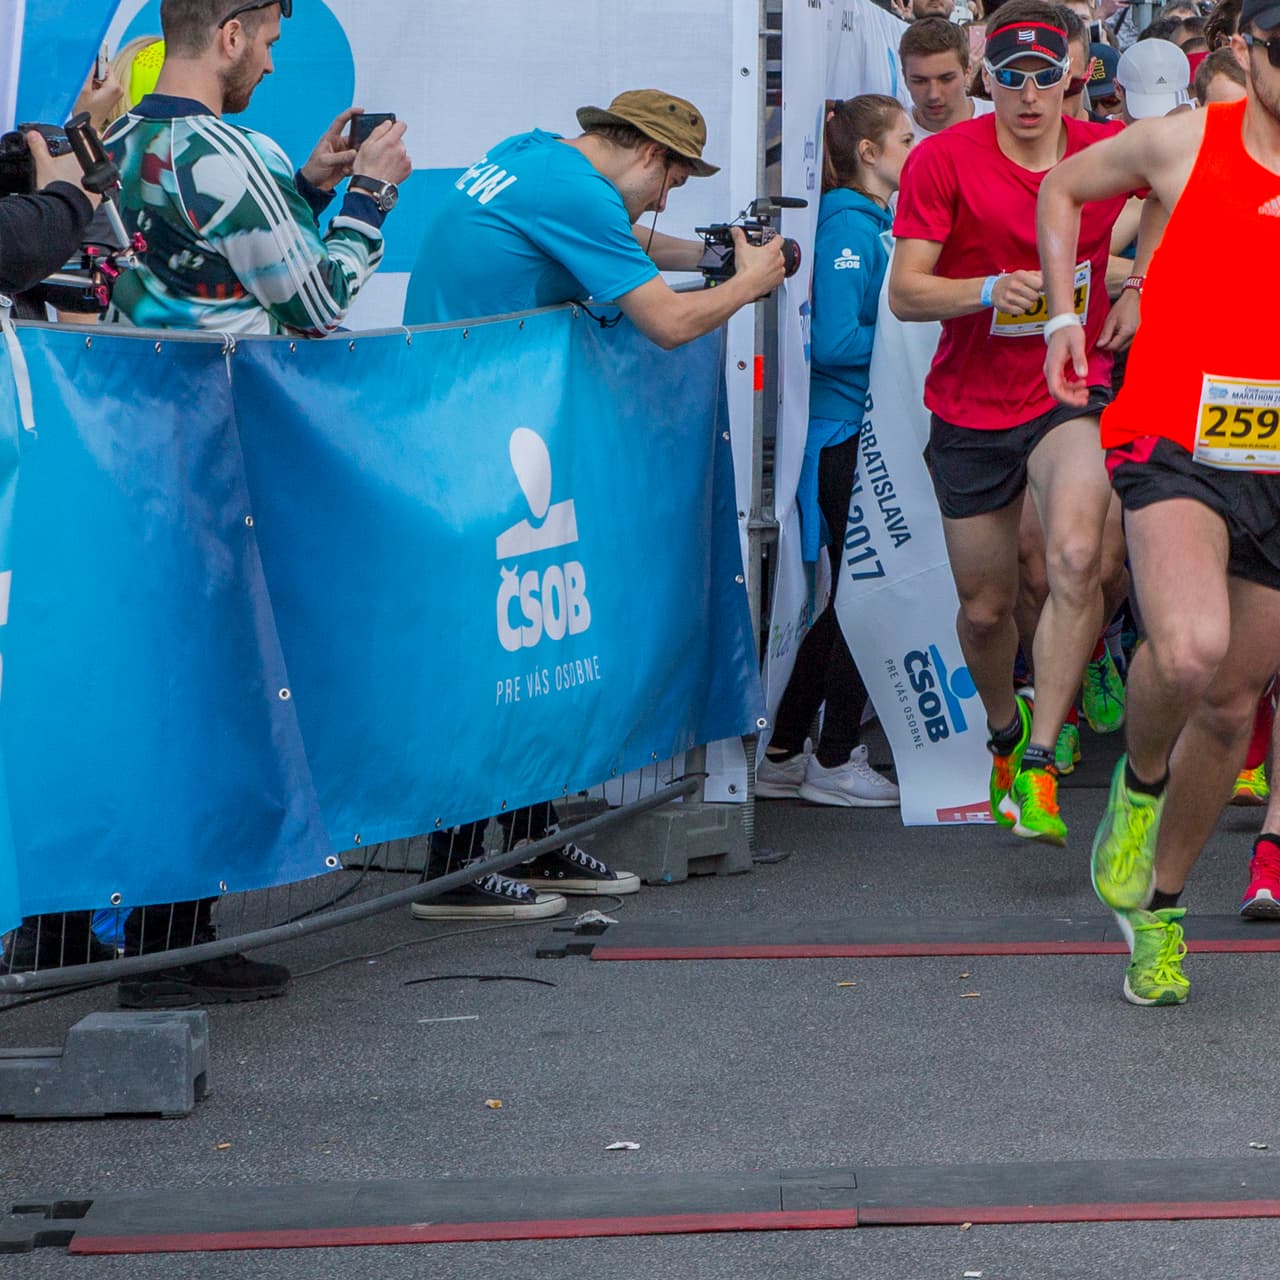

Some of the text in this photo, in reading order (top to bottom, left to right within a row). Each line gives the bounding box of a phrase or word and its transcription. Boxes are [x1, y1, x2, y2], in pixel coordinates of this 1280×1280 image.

[1231, 392, 1273, 401] MARATHON
[860, 420, 912, 549] BRATISLAVA
[845, 504, 886, 581] 2017
[496, 560, 592, 652] ČSOB
[496, 655, 601, 706] PRE VÁS OSOBNE
[884, 659, 924, 750] PRE VÁS OSOBNE
[904, 650, 950, 744] ČSOB
